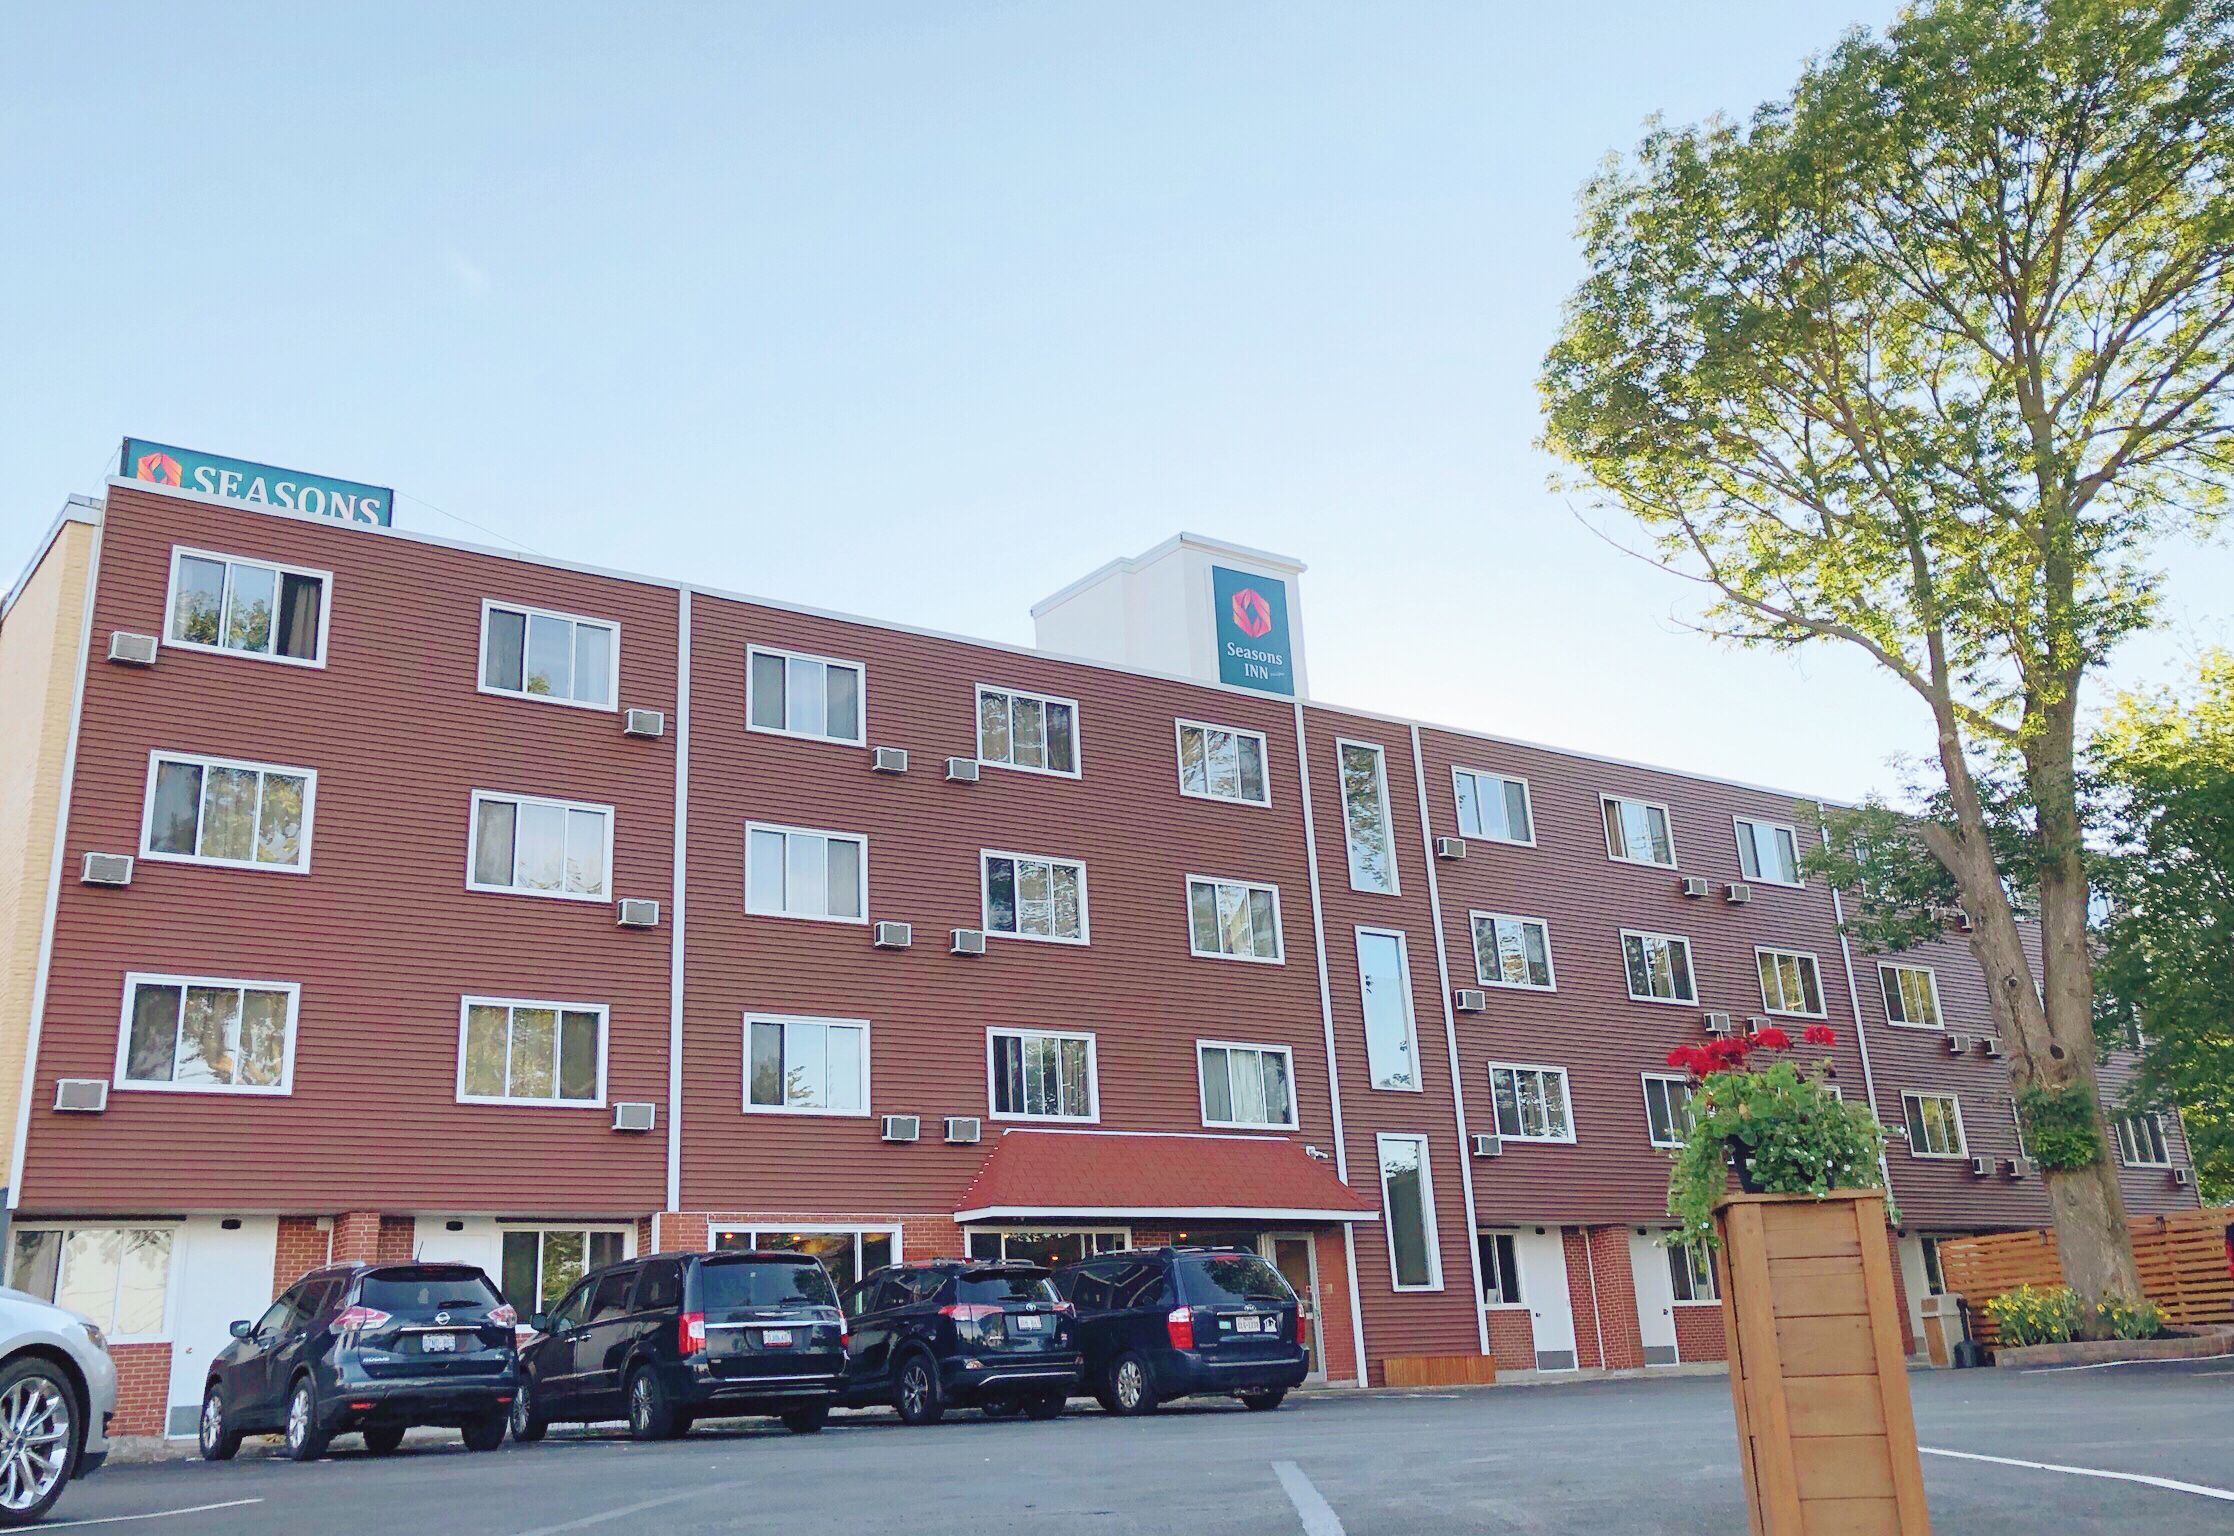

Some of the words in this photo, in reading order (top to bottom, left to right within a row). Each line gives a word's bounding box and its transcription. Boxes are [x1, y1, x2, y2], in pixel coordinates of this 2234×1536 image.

[192, 466, 380, 525] SEASONS
[1227, 641, 1283, 665] Seasons
[1244, 663, 1269, 680] INN
